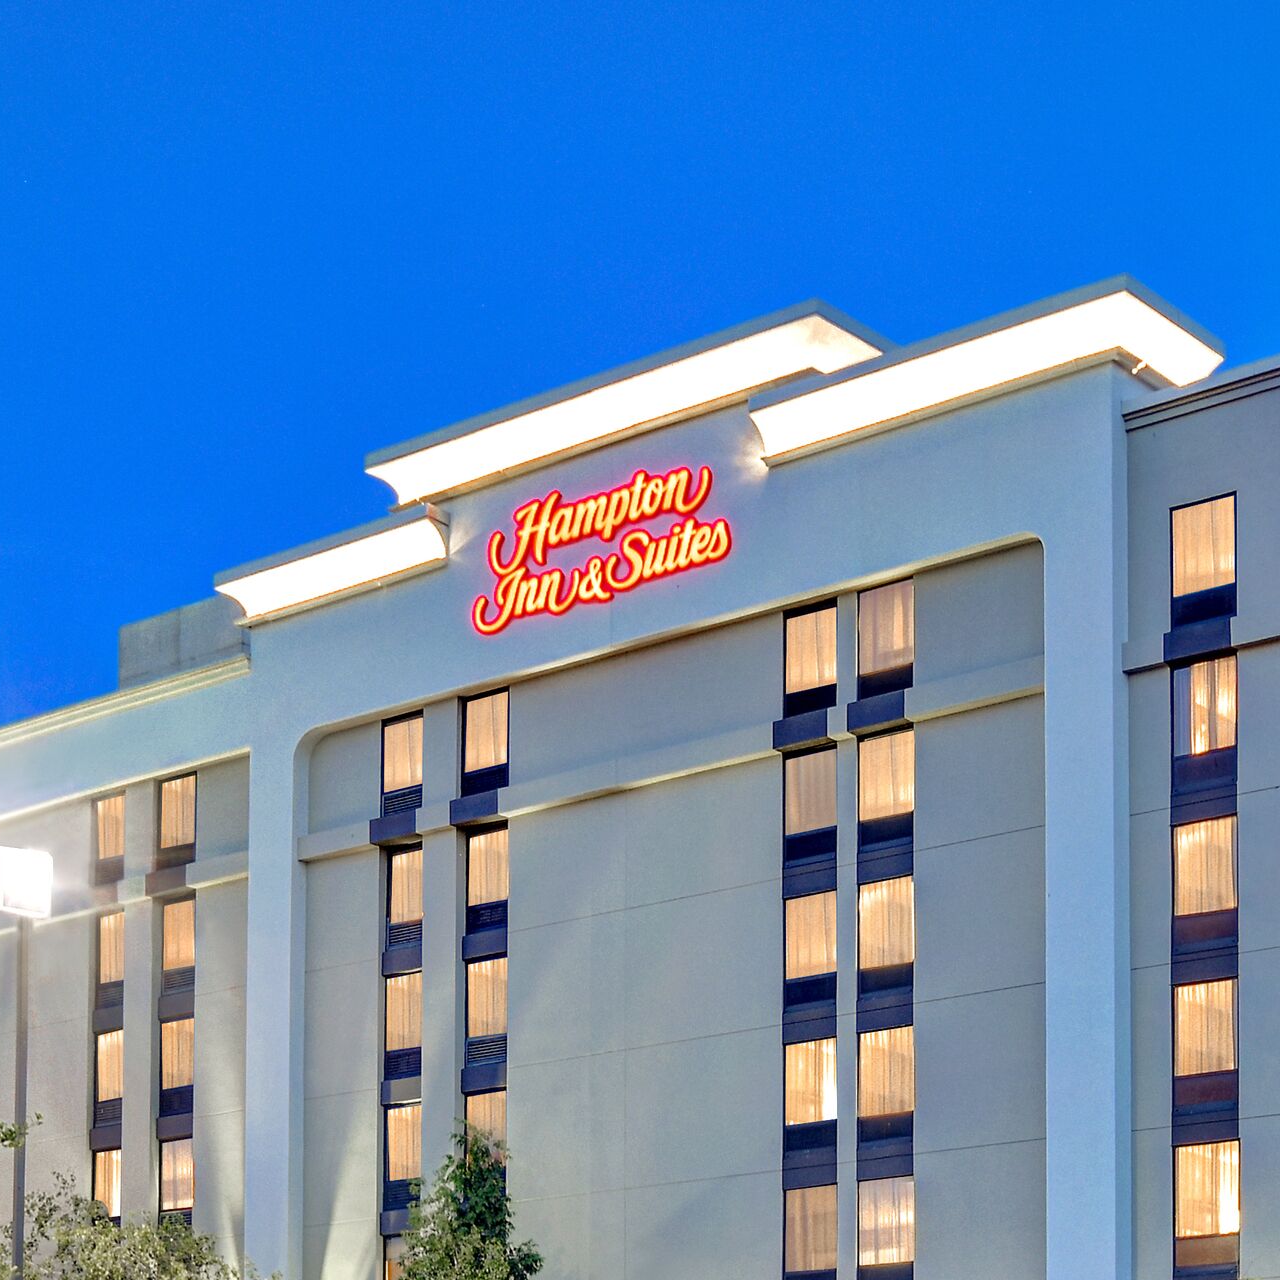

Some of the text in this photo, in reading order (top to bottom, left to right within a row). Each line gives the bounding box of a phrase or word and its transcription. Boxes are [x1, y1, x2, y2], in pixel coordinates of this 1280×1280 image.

[472, 516, 732, 636] Inn & Suites
[488, 465, 713, 574] Hampton
